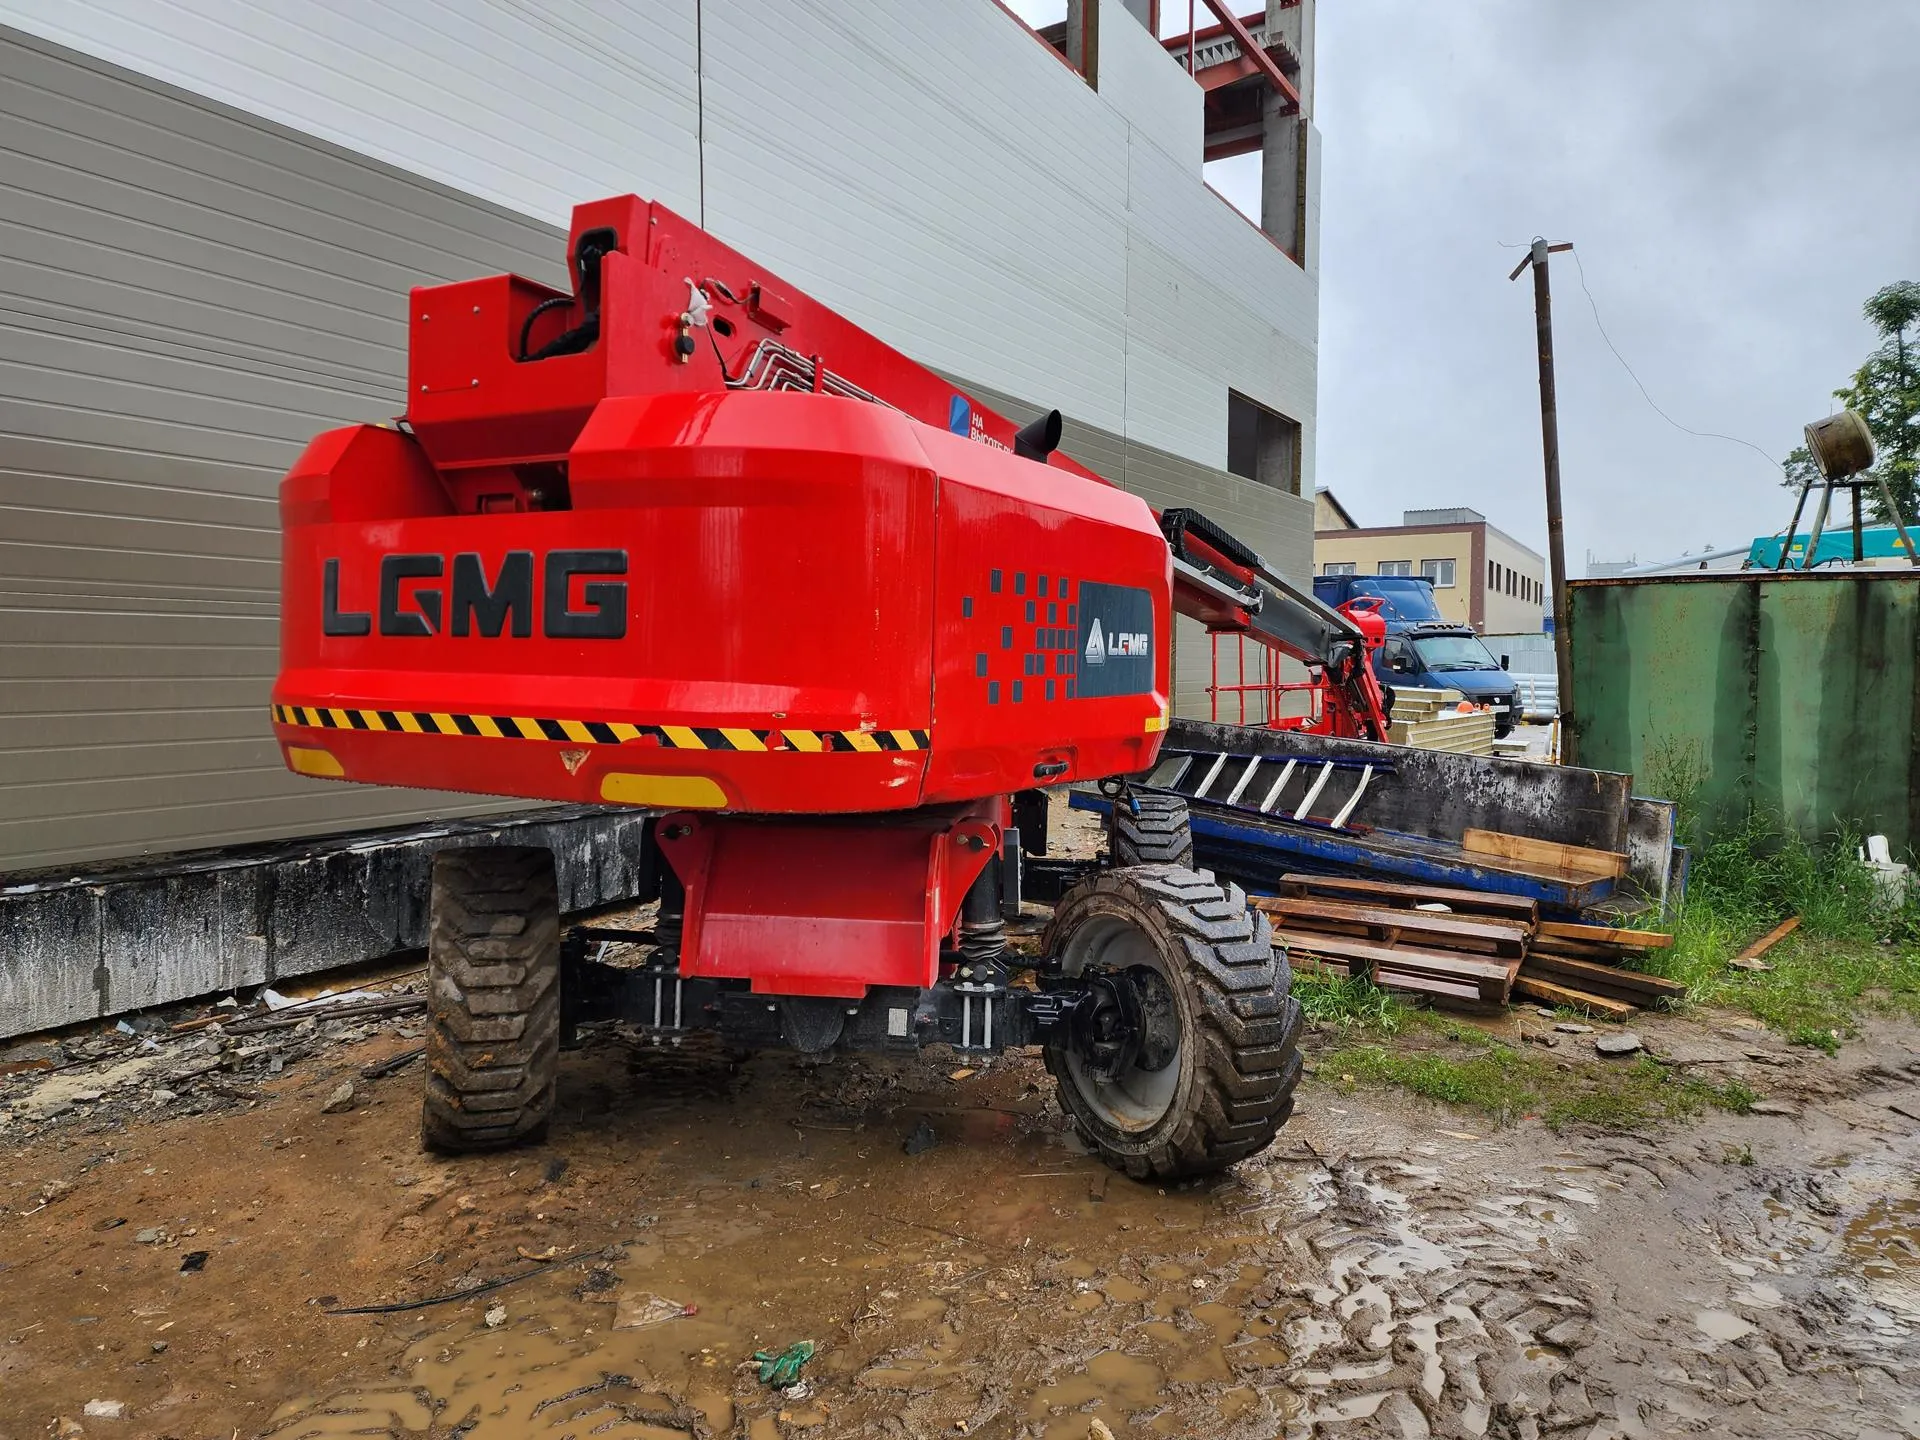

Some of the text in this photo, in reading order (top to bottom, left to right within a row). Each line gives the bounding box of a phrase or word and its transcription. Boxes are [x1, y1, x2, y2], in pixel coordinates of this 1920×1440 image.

[972, 412, 984, 430] НА
[322, 549, 628, 639] LGMG
[1108, 632, 1148, 655] LGMG
